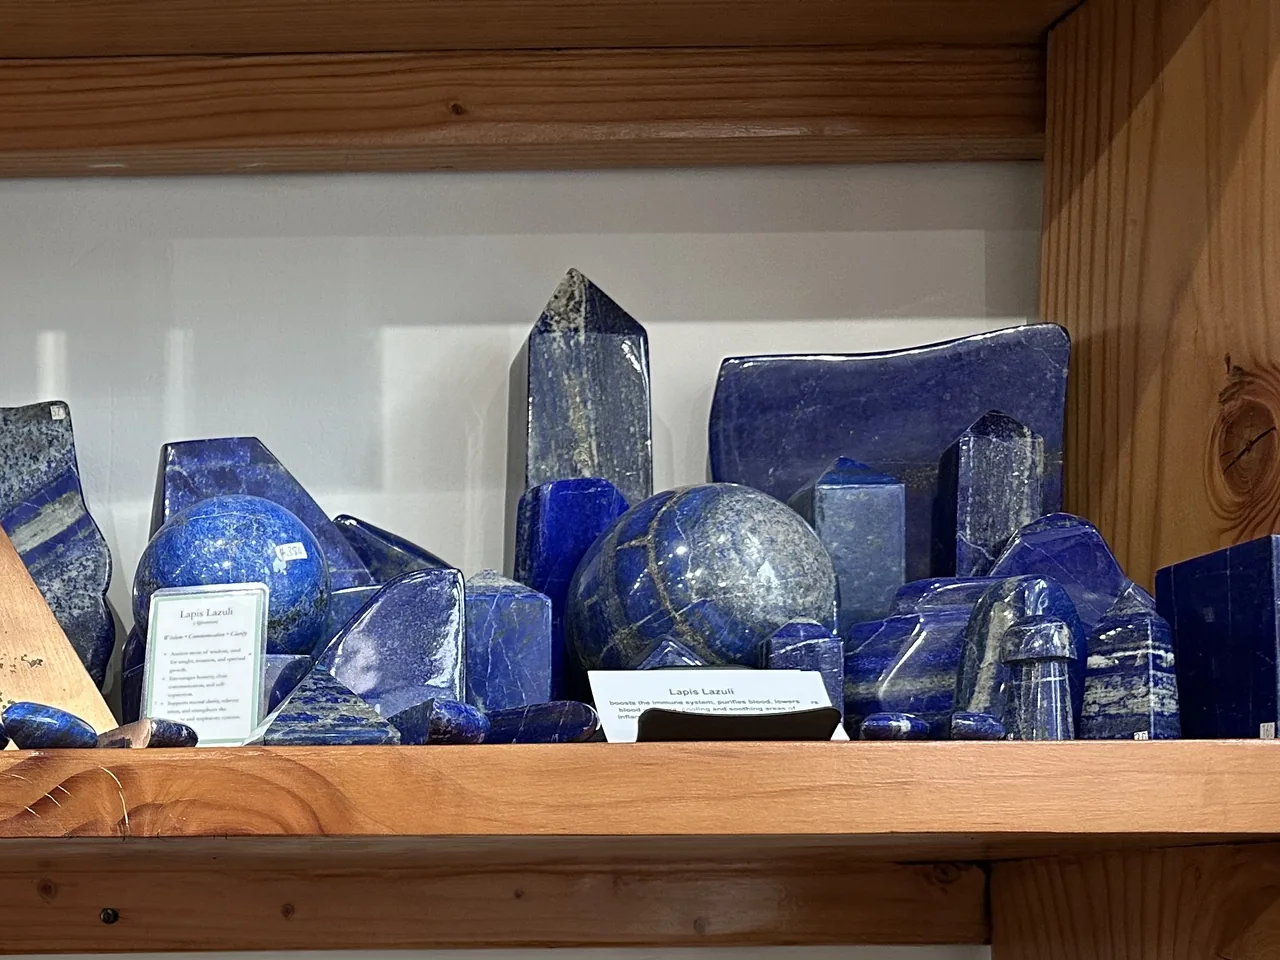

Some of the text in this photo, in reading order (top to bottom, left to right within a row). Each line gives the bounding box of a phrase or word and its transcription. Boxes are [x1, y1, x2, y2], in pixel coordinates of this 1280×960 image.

[180, 607, 233, 621] Lapis Lazuli
[669, 688, 734, 697] Lapis Lazuli
